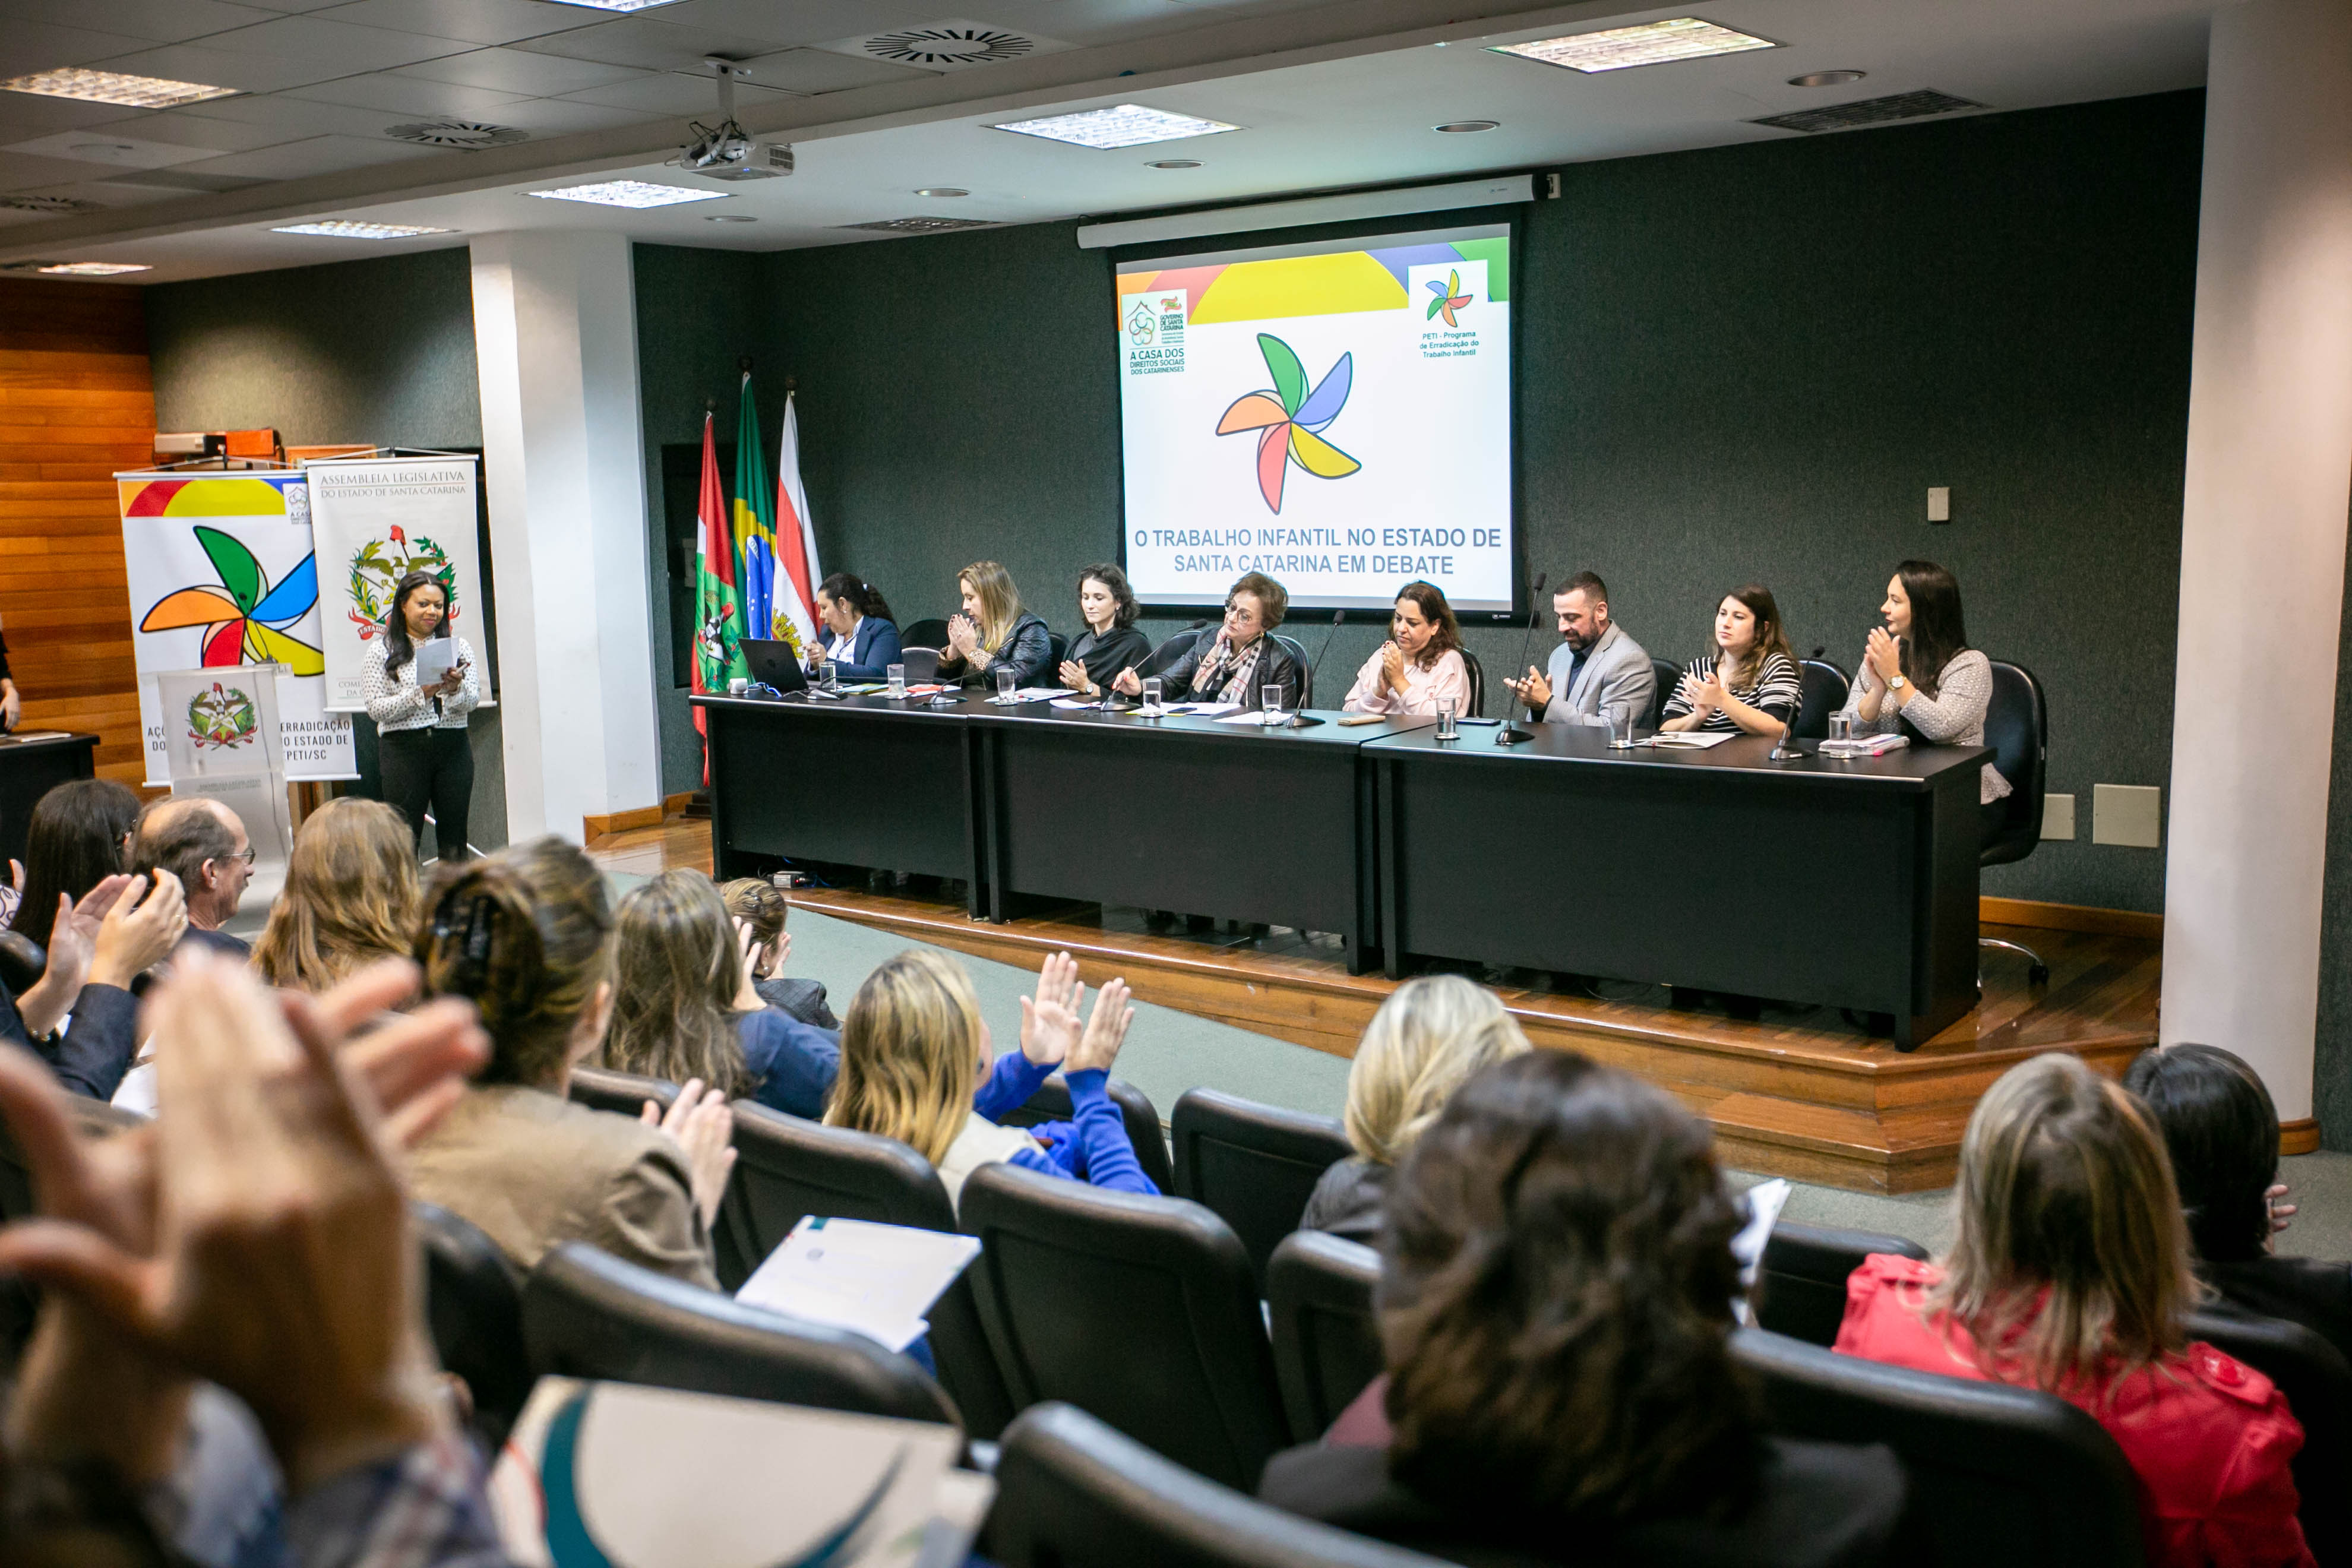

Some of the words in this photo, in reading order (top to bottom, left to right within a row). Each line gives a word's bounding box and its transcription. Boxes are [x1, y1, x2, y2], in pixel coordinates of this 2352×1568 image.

[1130, 351, 1136, 360] A
[1139, 350, 1162, 359] CASA
[1165, 348, 1184, 358] DOS
[321, 473, 389, 485] ASSEMBLEIA
[394, 471, 464, 482] LEGISLATIVA
[321, 489, 335, 498] DO
[339, 488, 372, 498] ESTADO
[376, 488, 385, 497] DE
[390, 487, 418, 496] SANTA
[421, 485, 466, 495] CATARINA
[1135, 530, 1147, 547] O
[1153, 529, 1251, 546] TRABALHO
[1258, 528, 1341, 546] INFANTIL
[1348, 528, 1376, 546] NO
[1383, 528, 1465, 547] ESTADO
[1473, 529, 1501, 547] DE
[1174, 555, 1233, 571] SANTA
[1238, 555, 1332, 572] CATARINA
[1338, 555, 1365, 573] EM
[1373, 555, 1453, 574] DEBATE
[280, 719, 350, 733] ERRADICAÇÃO
[152, 741, 166, 751] DO
[294, 735, 331, 746] ESTADO
[336, 734, 348, 745] DE
[283, 750, 327, 760] PETI/SC
